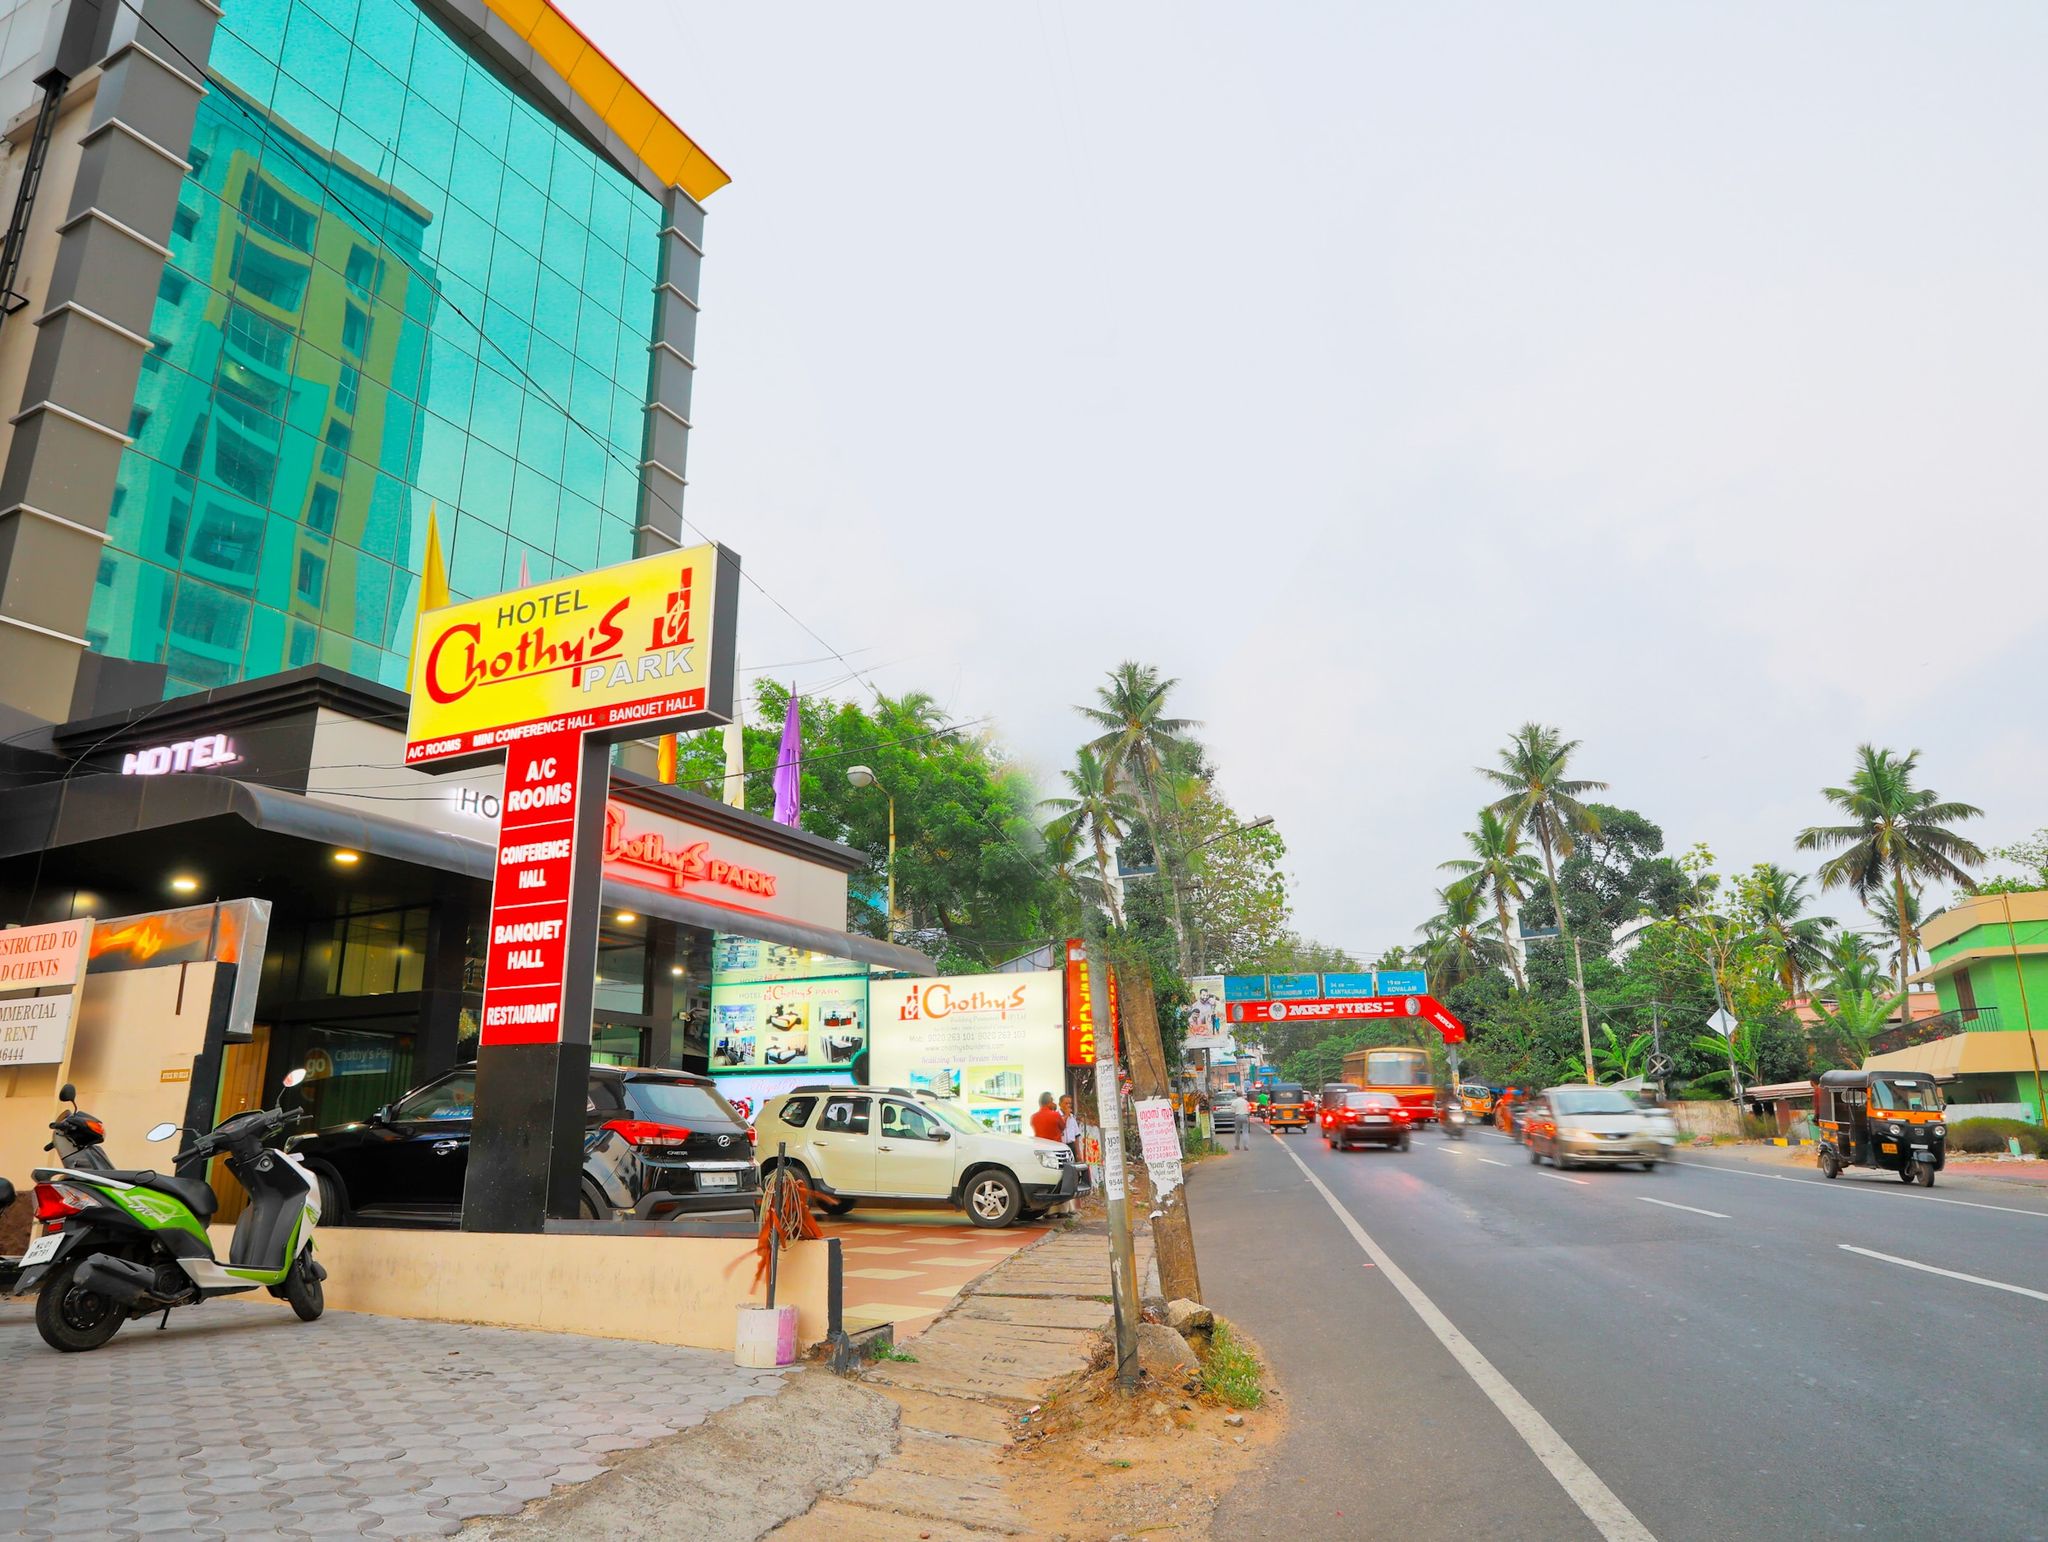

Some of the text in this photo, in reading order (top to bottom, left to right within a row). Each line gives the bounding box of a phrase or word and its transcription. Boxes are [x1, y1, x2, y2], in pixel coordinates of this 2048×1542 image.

[497, 589, 588, 628] HOTEL
[583, 646, 694, 693] PARK
[408, 745, 425, 759] A/C
[426, 738, 462, 756] ROOMS
[495, 719, 566, 743] CONFERENCE
[567, 714, 596, 729] HALL
[609, 700, 664, 723] BANQUET
[665, 696, 697, 713] HALL
[122, 733, 237, 775] HOTEL
[525, 757, 557, 782] A/C
[507, 782, 573, 812] ROOMS
[500, 838, 571, 865] CONFERENCE
[518, 868, 547, 889] HALL
[710, 859, 777, 897] PARK
[61, 930, 78, 948] TO
[494, 919, 564, 945] BANQUET
[11, 958, 60, 980] CLIENTS
[507, 949, 545, 970] HALL
[486, 1002, 558, 1026] RESTAURANT
[1289, 1002, 1383, 1016] MRF TYRES
[4, 1025, 37, 1043] RENT
[306, 1058, 326, 1077] go
